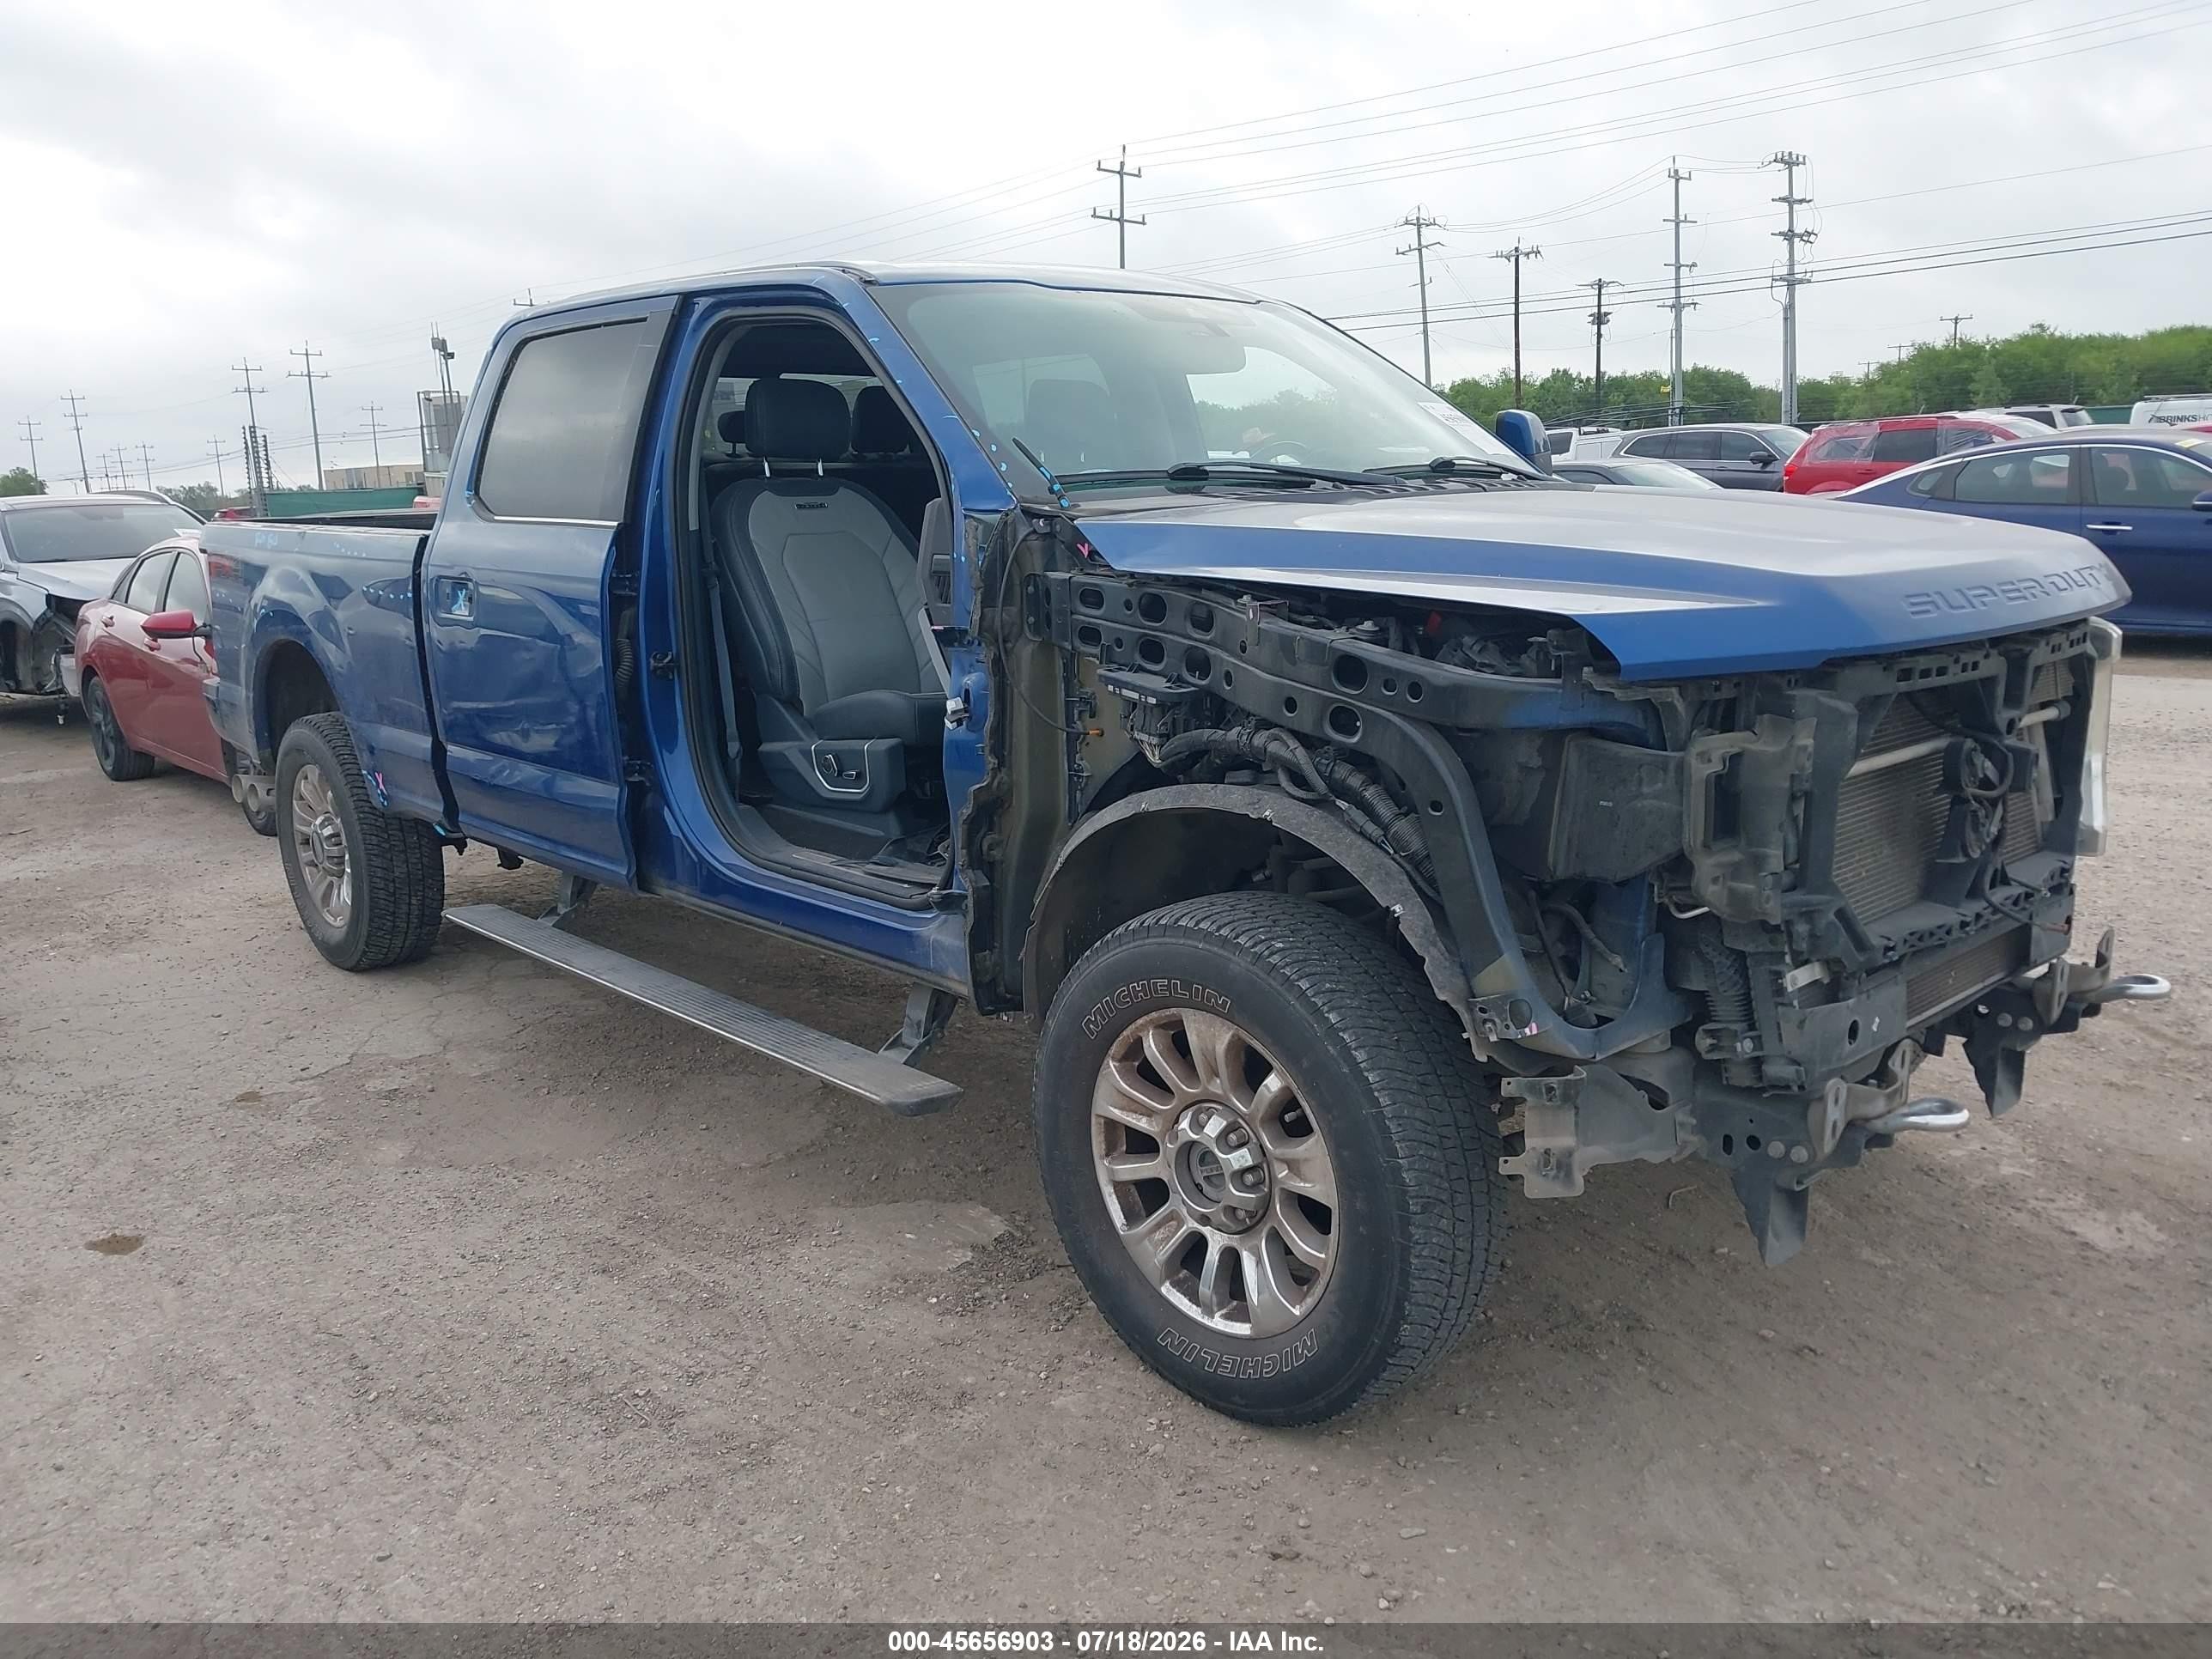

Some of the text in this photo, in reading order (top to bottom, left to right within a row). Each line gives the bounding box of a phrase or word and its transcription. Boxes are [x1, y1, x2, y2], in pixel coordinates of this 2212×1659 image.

[2160, 414, 2197, 422] BRINKS
[1081, 979, 1231, 1040] MICHELIN
[1157, 1327, 1319, 1378] MICHELIN
